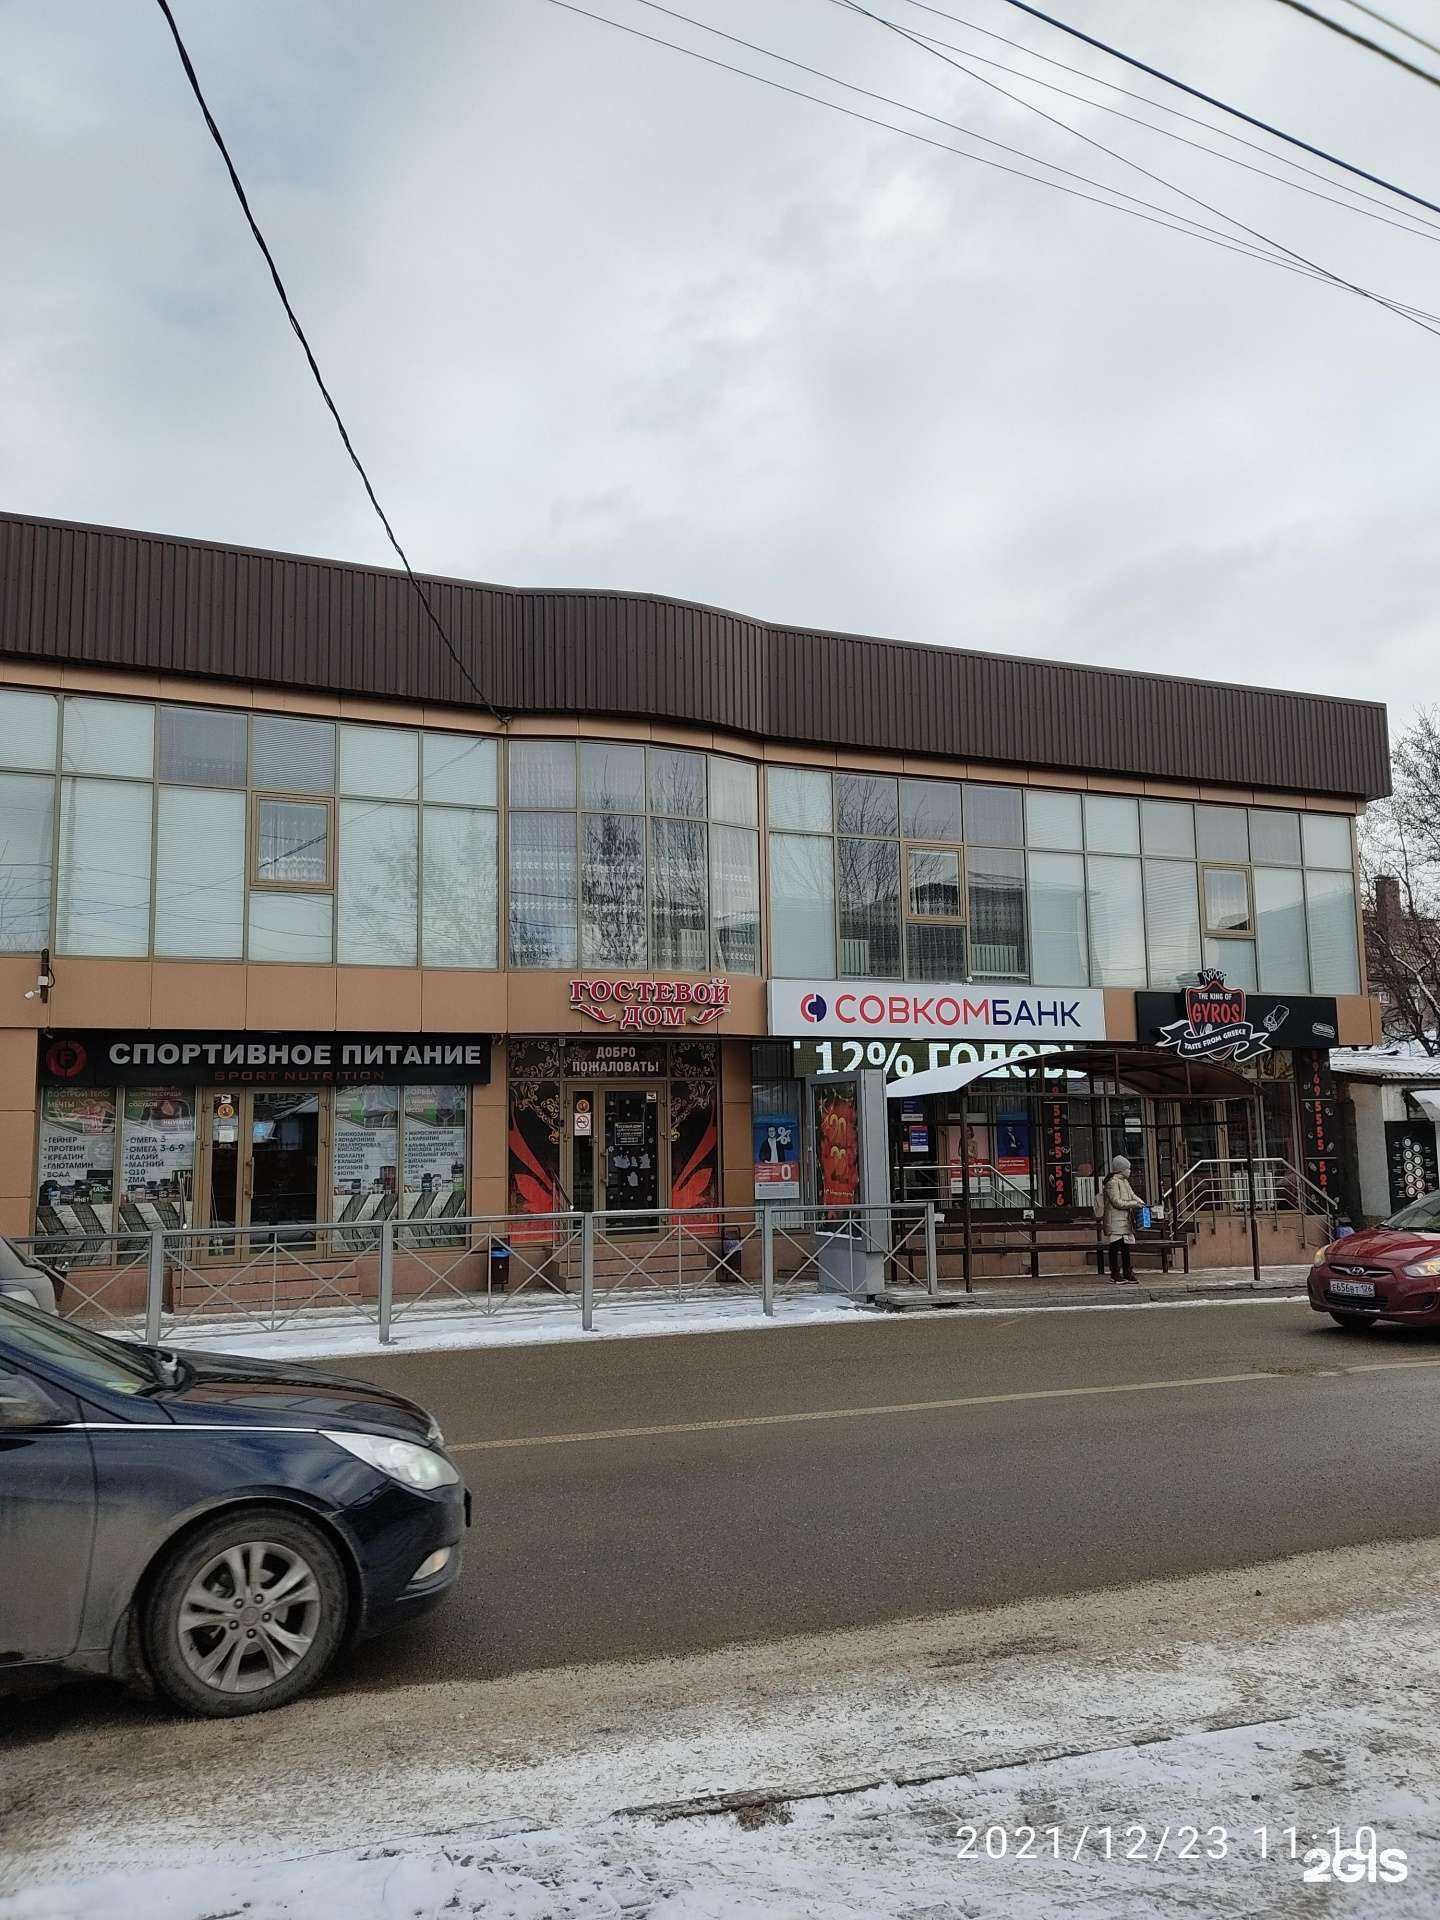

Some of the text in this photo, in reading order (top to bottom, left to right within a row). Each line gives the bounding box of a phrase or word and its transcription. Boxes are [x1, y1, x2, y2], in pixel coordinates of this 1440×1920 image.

[570, 977, 731, 1004] ГОСТЕВОЙ
[835, 994, 1081, 1027] СОВКОМБАНК
[1192, 1002, 1240, 1023] GYROS
[620, 1005, 686, 1030] ДОМ
[1184, 1028, 1247, 1050] TASTE FROM GREECE
[109, 1043, 481, 1065] СПОРТИВНОЕ ПИТАНИЕ
[596, 1046, 636, 1059] ДОБРО
[815, 1041, 915, 1078] 12%
[572, 1061, 659, 1073] ПОЖАЛОВАТЬ!
[214, 1071, 384, 1081] SPORT NUTRITION
[48, 1136, 78, 1144] ГЕЙНЕР
[130, 1136, 158, 1144] ОМЕГА
[48, 1145, 85, 1153] ПРОТЕИН
[129, 1144, 185, 1153] ОМЕГА 3-6-9
[47, 1153, 84, 1161] КРЕАТИН
[129, 1153, 159, 1161] КАЛИЙ
[47, 1161, 94, 1169] ГЛЮТАМИН
[128, 1160, 164, 1168] МАГНИЙ
